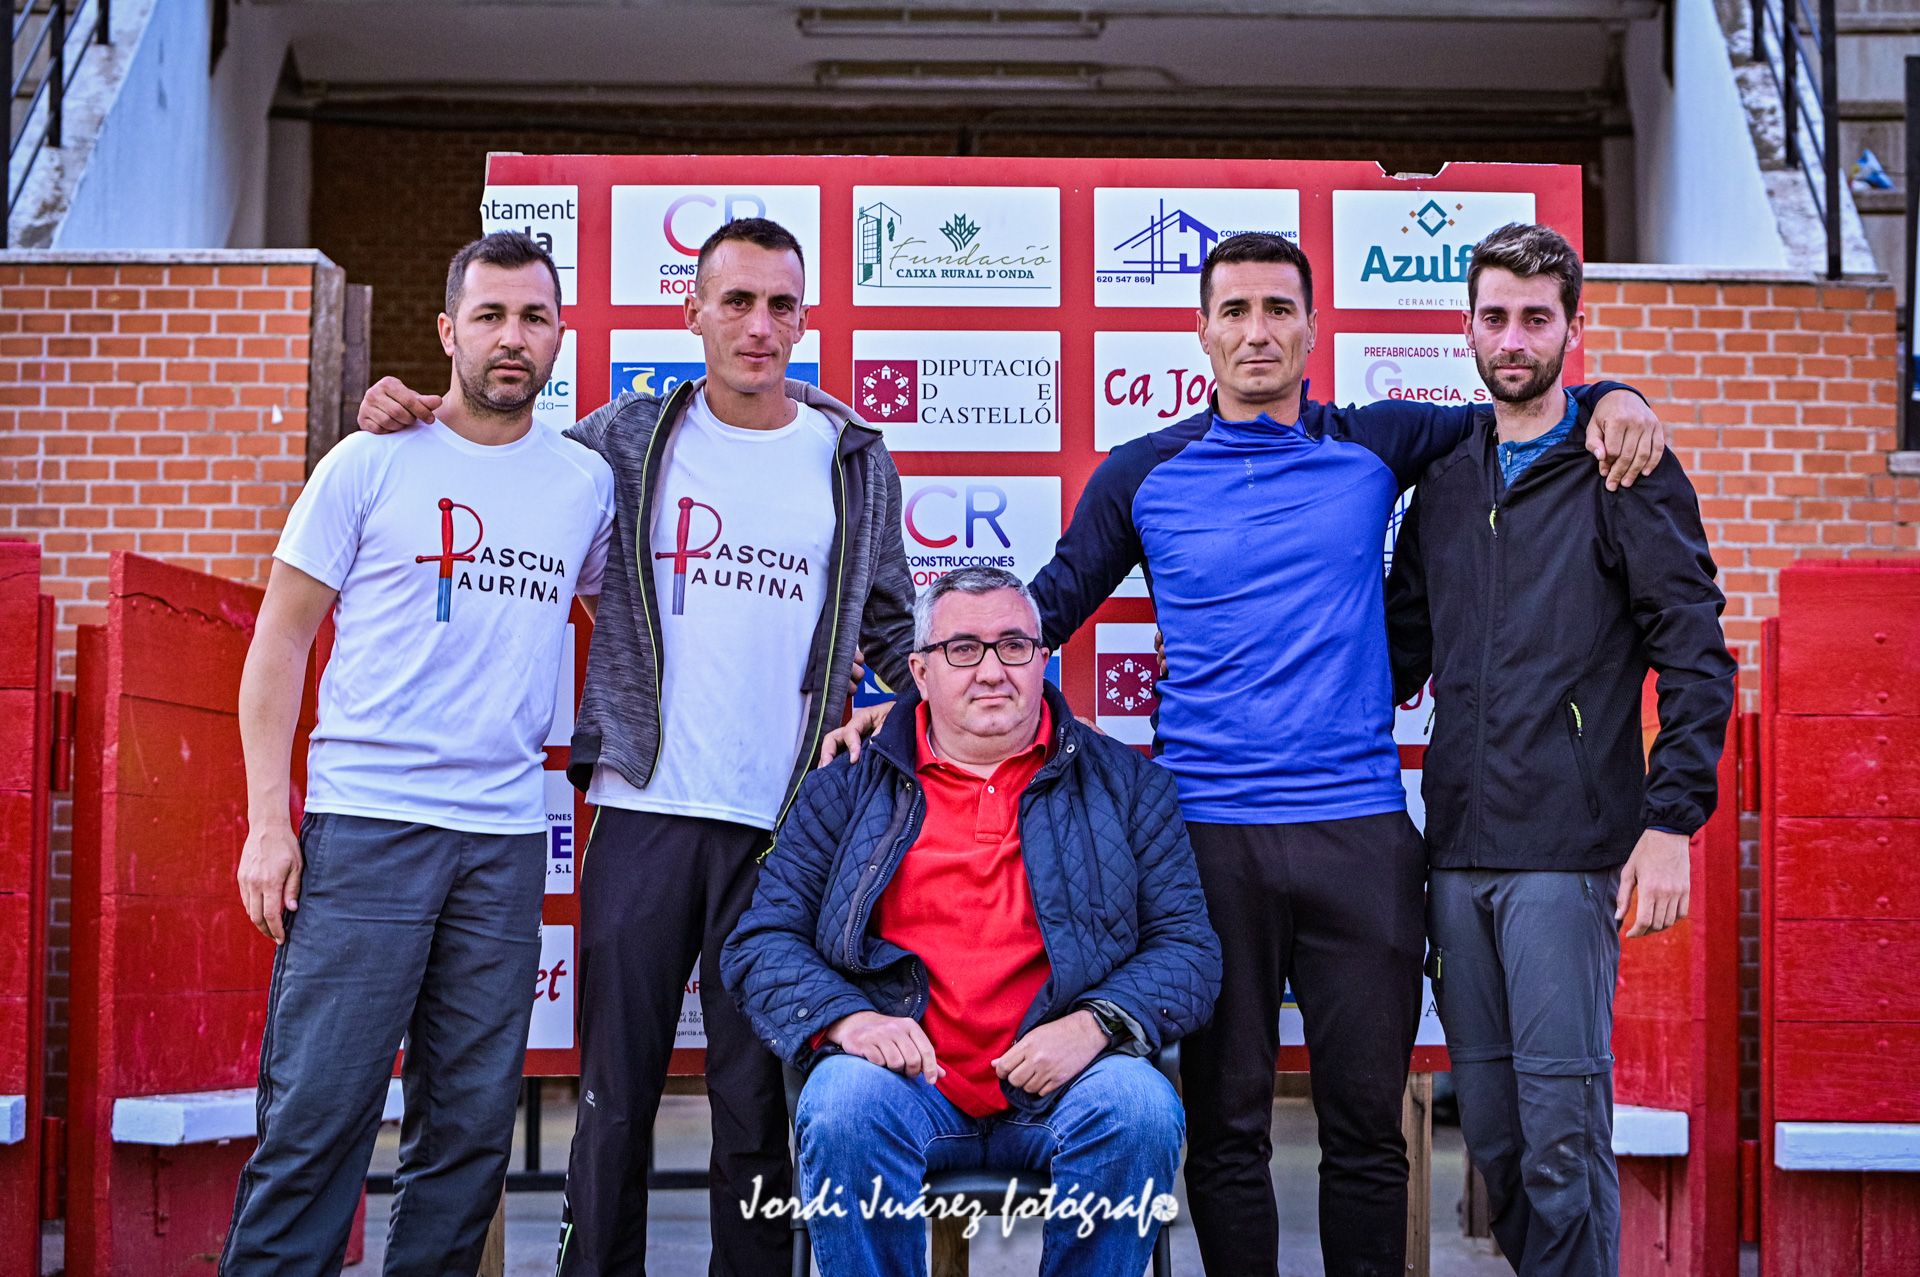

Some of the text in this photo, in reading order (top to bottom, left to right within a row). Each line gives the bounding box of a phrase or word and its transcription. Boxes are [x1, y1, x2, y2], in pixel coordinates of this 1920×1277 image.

[889, 237, 1052, 270] Fundació
[896, 269, 1035, 279] CAIXA RURAL D'ONDA
[1364, 347, 1439, 357] PREFABRICADOS
[1443, 348, 1449, 357] Y
[922, 357, 1051, 377] DIPUTACIÓ
[1104, 367, 1154, 407] Ca
[1387, 385, 1467, 403] GARCÍA,
[921, 402, 1051, 424] CASTELLÓ
[905, 485, 1011, 549] CR
